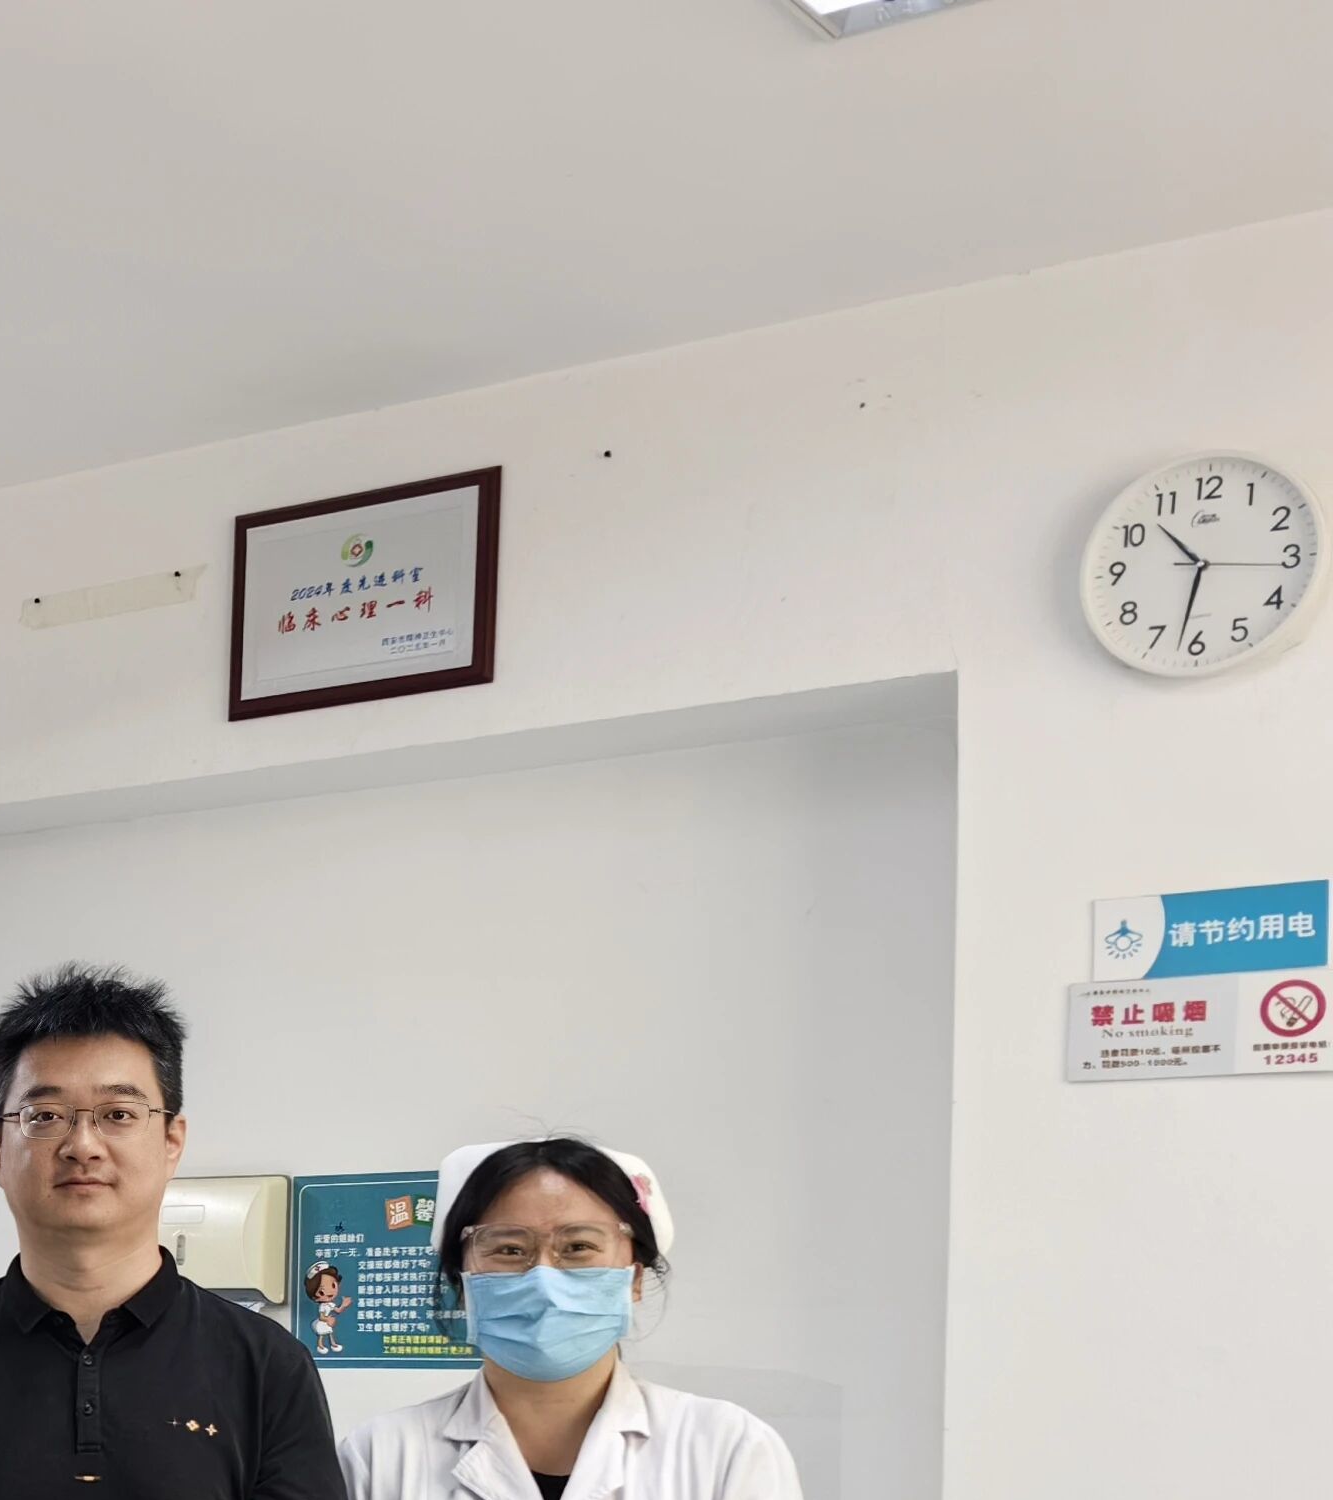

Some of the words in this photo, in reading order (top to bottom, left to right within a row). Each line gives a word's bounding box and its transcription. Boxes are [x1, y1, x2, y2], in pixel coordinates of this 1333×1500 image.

[1196, 476, 1223, 501] 12
[1246, 482, 1256, 506] 1
[1156, 491, 1177, 516] 11
[1270, 506, 1291, 532] 2
[1122, 523, 1145, 548] 10
[1281, 544, 1301, 569] 3
[290, 566, 424, 602] 2024年度先进科室
[1109, 561, 1127, 586] 9
[278, 586, 435, 634] 临床心理一科
[1263, 585, 1284, 610] 4
[1119, 601, 1138, 625] 8
[1148, 625, 1166, 650] 7
[1230, 617, 1249, 642] 5
[1188, 630, 1206, 656] 6
[1168, 911, 1316, 948] 请节约用电
[1090, 1000, 1208, 1027] 禁止吸烟
[1101, 1028, 1124, 1039] No
[1129, 1025, 1194, 1038] smoking
[1263, 1052, 1318, 1066] 12345
[388, 1197, 435, 1226] 温馨
